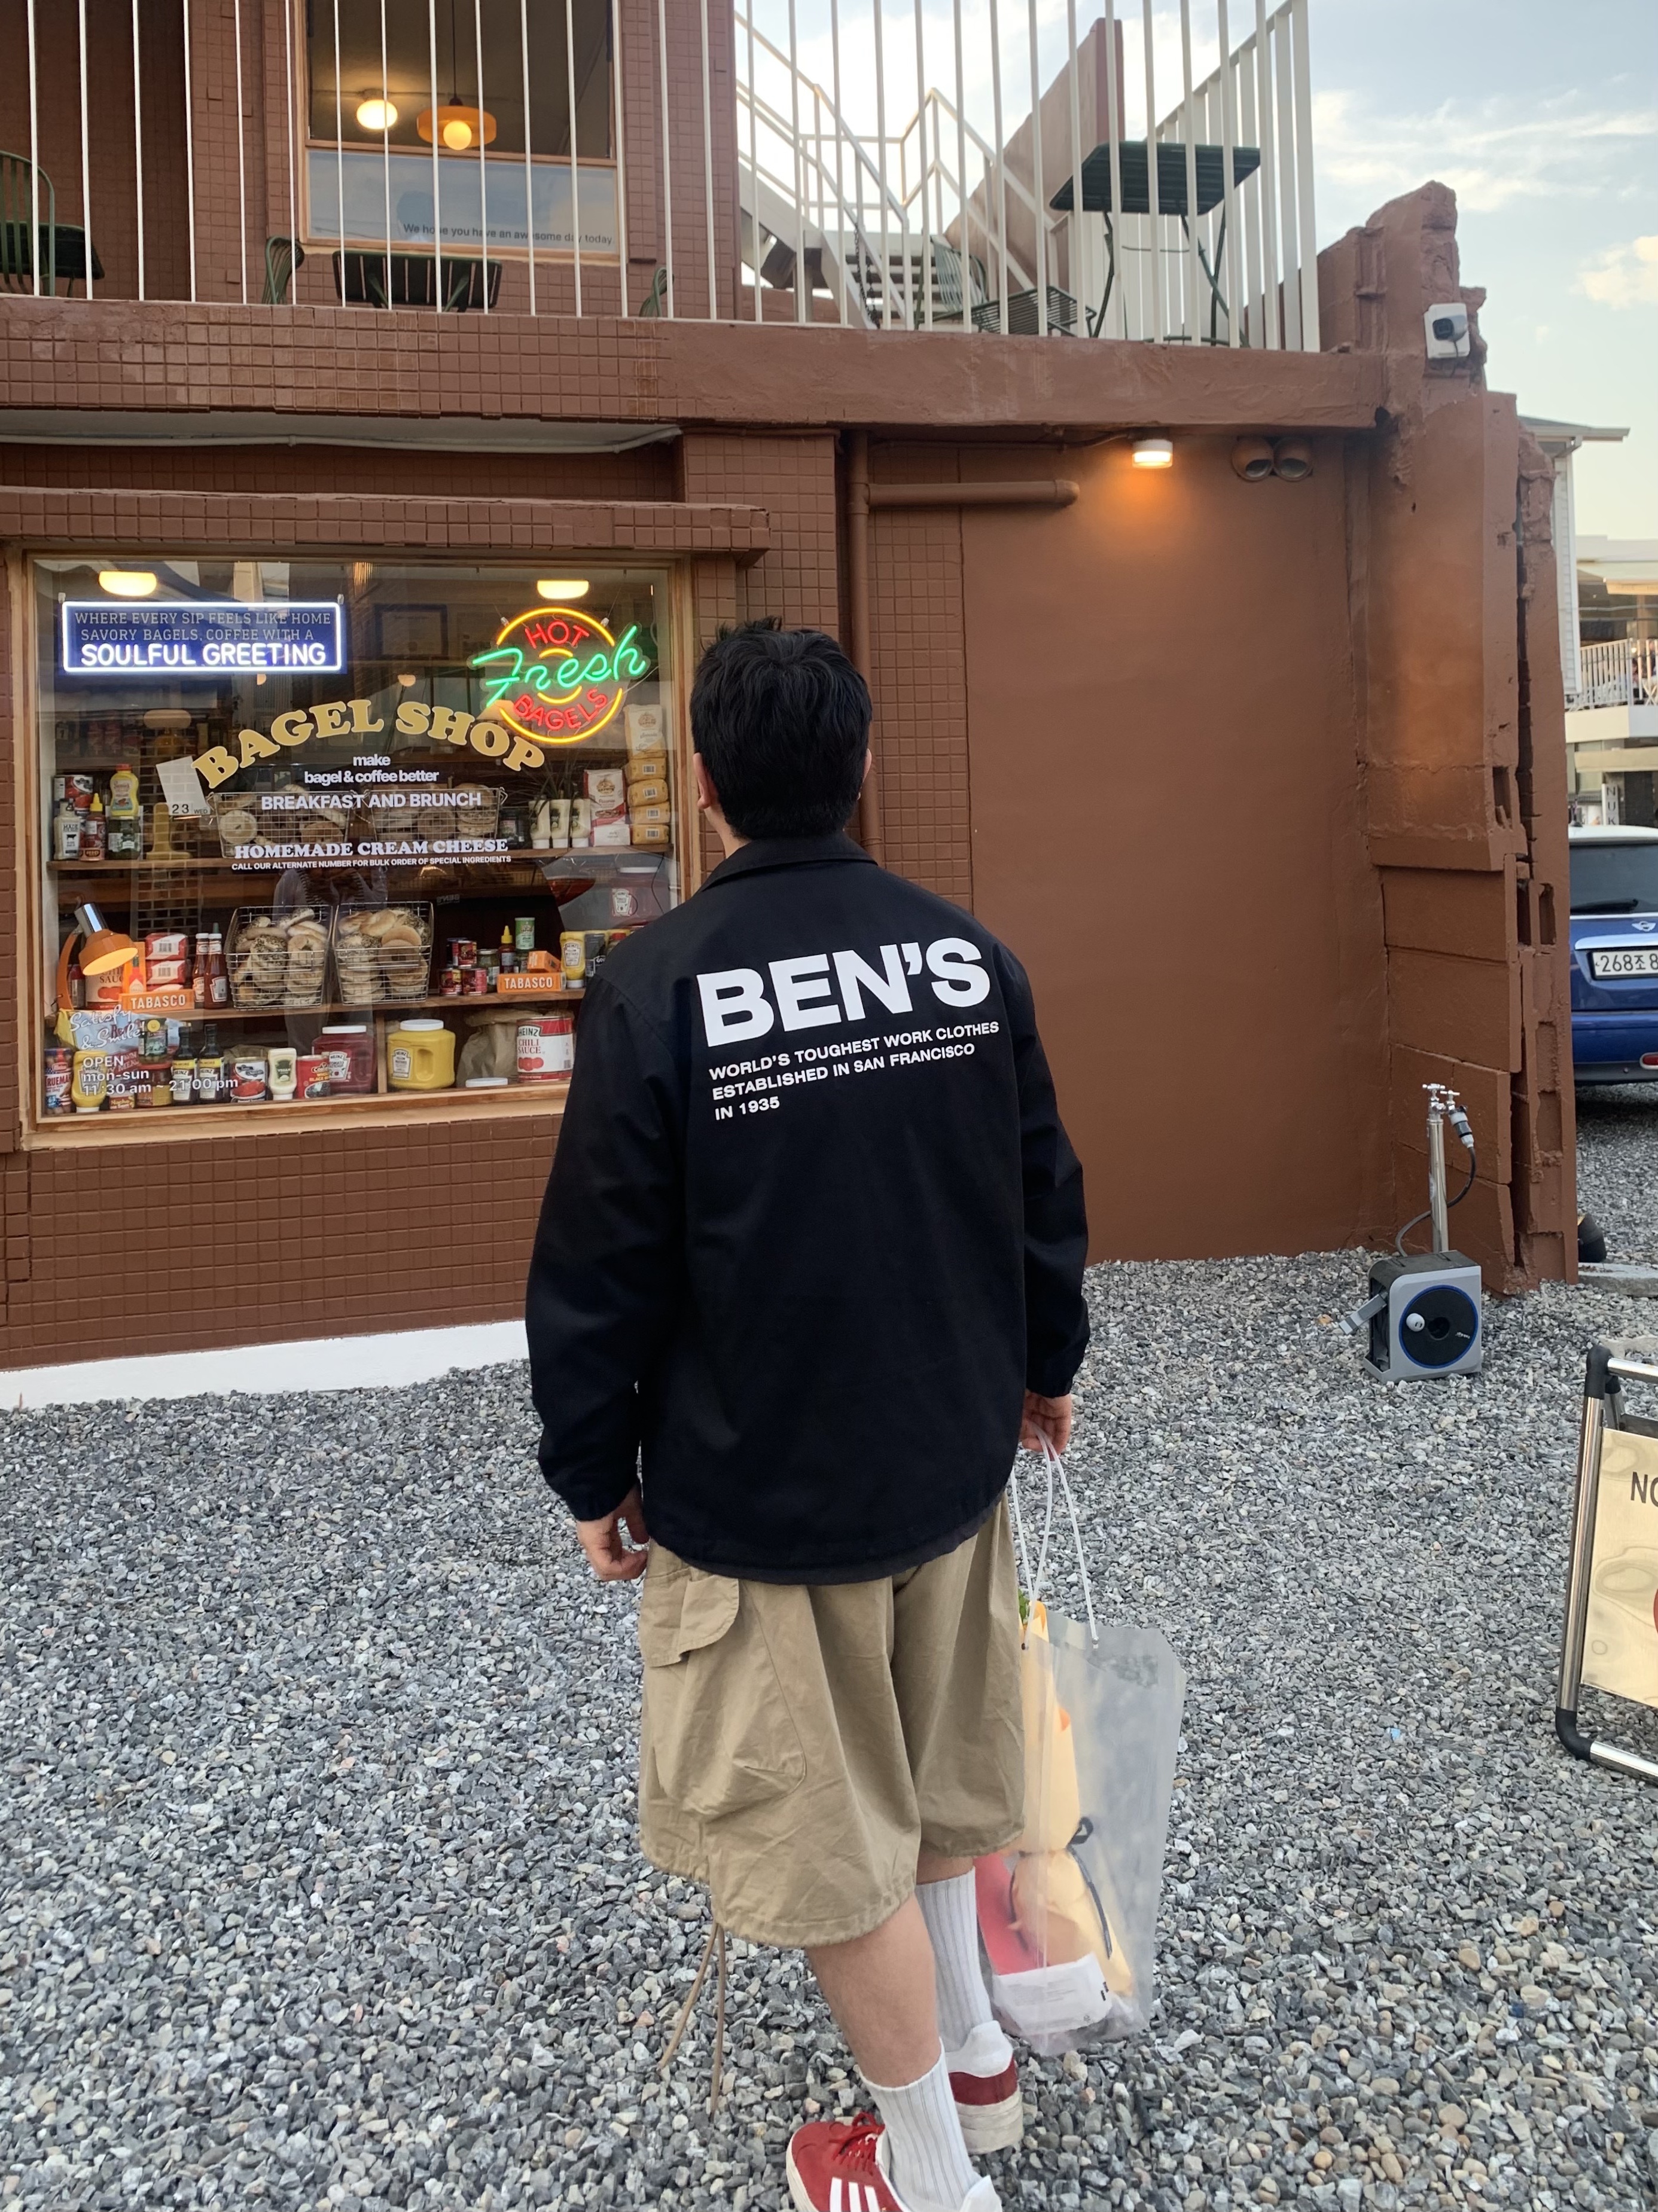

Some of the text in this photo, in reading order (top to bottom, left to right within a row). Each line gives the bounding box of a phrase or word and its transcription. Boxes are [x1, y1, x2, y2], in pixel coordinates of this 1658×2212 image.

[403, 223, 420, 233] We
[422, 224, 448, 236] hoe
[451, 227, 470, 238] you
[585, 234, 612, 245] today
[75, 612, 331, 624] WHERE EVERY SIP FEELS LIKE HOME
[81, 628, 314, 642] SAVORY BAGELS, COFFEE WITH A
[524, 620, 590, 649] HOT
[81, 642, 327, 666] SOULFUL GREETING
[472, 624, 646, 709] Fresh
[513, 688, 608, 731] BAGELS
[190, 699, 545, 789] BAGEL SHOP
[353, 753, 391, 767] make
[304, 769, 440, 786] bagel & coffee better
[172, 804, 189, 814] 23
[261, 792, 481, 810] BREAKFAST AND BRUNCH
[234, 838, 508, 859] HOMEMADE CREAM CHEESE
[231, 862, 252, 871] CALL
[272, 861, 318, 869] ALTERNATE
[391, 858, 417, 866] ORDER
[429, 856, 462, 865] SPECIAL
[462, 855, 511, 864] INGREDIENTS
[504, 976, 553, 990] TABASCO
[696, 937, 991, 1048] BEN'S
[130, 994, 186, 1009] TABASCO
[69, 1003, 132, 1032] Satisfy
[81, 1034, 95, 1050] &
[96, 1020, 145, 1048] Smile!
[83, 1055, 124, 1068] OPEN
[708, 1021, 1000, 1081] WORLD'S TOUGHEST WORK CLOTHES
[83, 1069, 150, 1082] mon-sun
[712, 1043, 976, 1100] ESTABLISHED IN SAN FRANCISCO
[83, 1082, 126, 1096] 11:30
[129, 1083, 152, 1094] am
[168, 1078, 212, 1092] 21:00
[216, 1078, 239, 1091] pm
[714, 1096, 781, 1121] IN 1935
